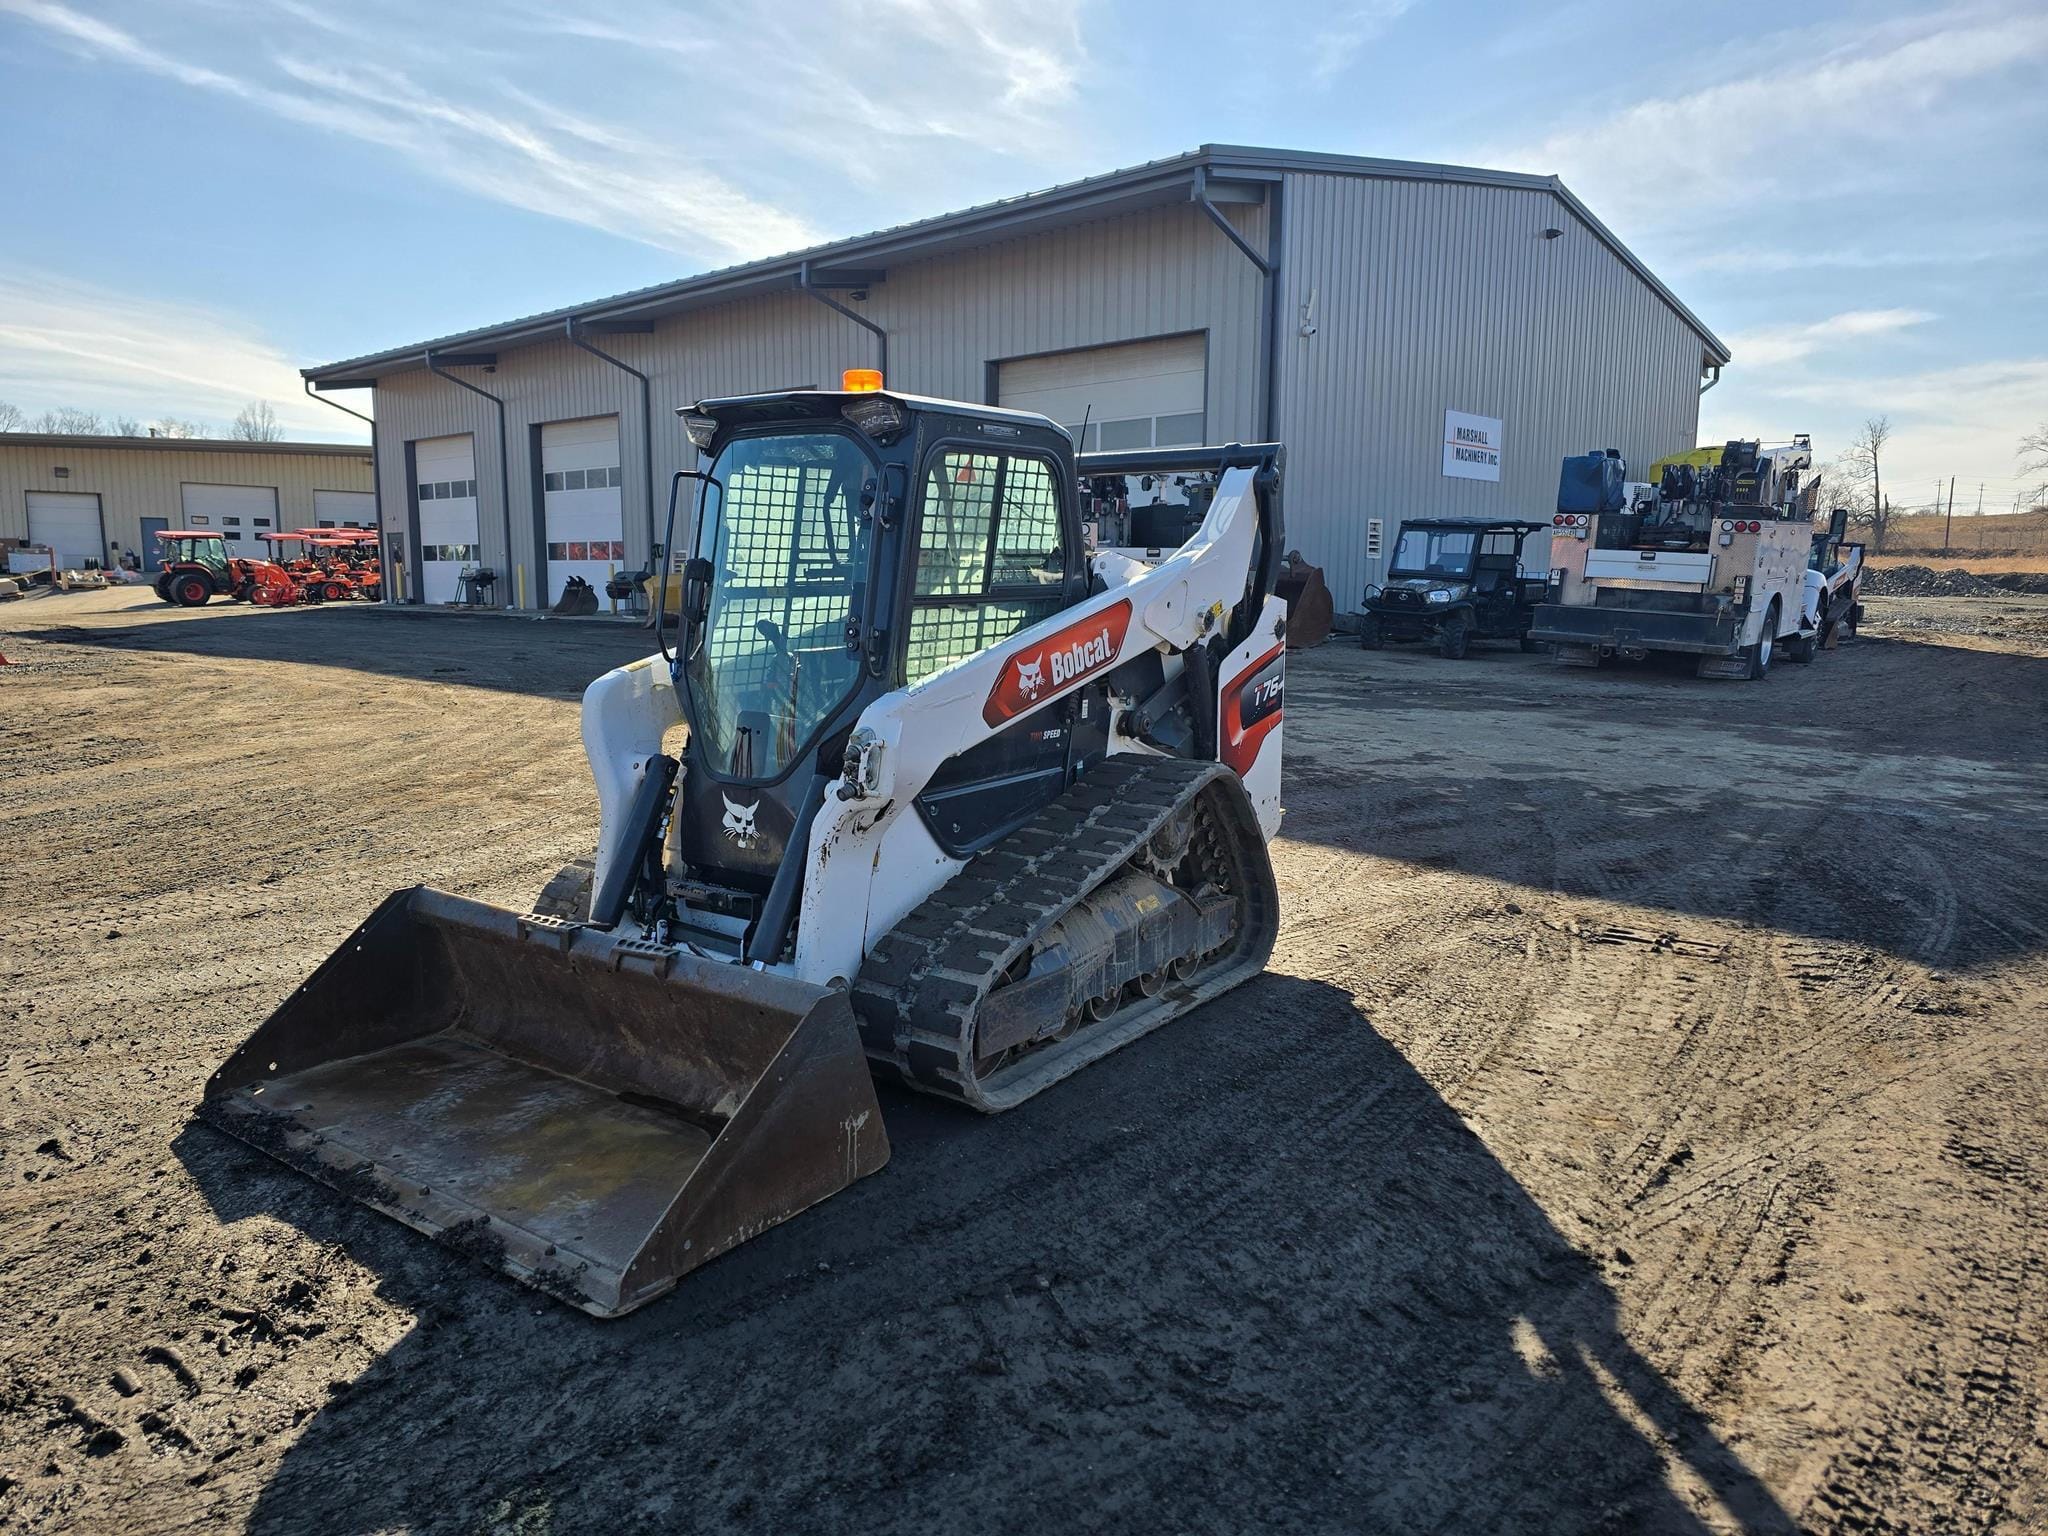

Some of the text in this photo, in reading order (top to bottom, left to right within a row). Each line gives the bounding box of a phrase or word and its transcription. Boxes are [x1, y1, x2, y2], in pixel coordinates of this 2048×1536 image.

[1456, 427, 1488, 444] MARSHALL
[1455, 447, 1487, 464] MACHINERY
[1050, 628, 1111, 686] Bobcat
[1042, 728, 1061, 740] SPEED
